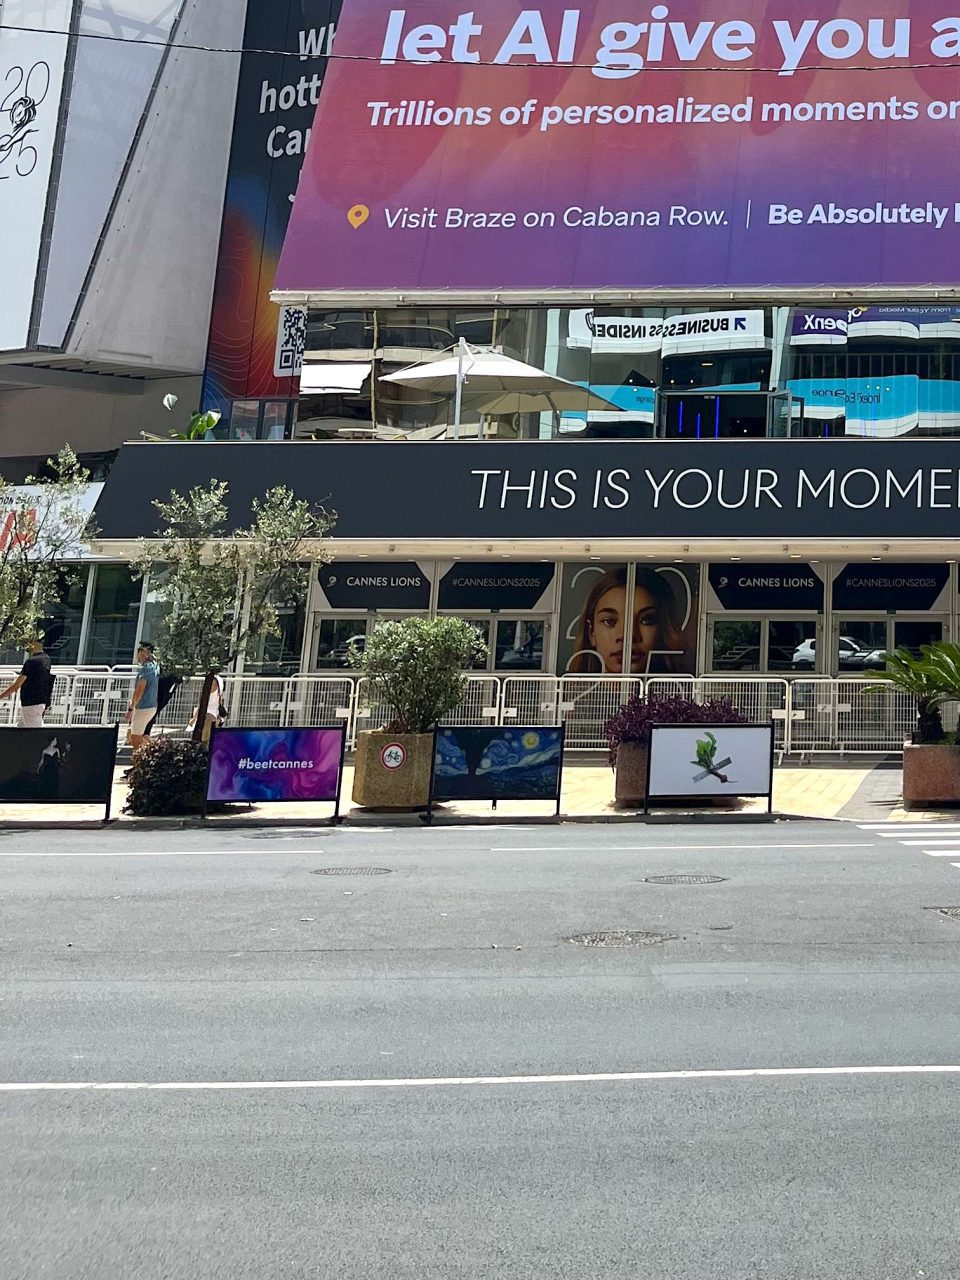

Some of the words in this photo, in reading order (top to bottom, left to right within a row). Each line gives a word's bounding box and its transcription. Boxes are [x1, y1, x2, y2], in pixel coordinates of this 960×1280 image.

[380, 10, 483, 65] let
[493, 10, 581, 64] AI
[591, 5, 756, 80] give
[771, 18, 911, 77] you
[366, 100, 492, 127] Trillions
[500, 99, 538, 125] of
[540, 96, 753, 132] personalized
[761, 96, 919, 122] moments
[384, 207, 438, 229] Visit
[444, 207, 517, 229] Braze
[524, 212, 555, 228] on
[562, 206, 661, 228] Cabana
[669, 205, 729, 227] Row.
[768, 203, 803, 225] Be
[808, 202, 949, 229] Absolutely
[471, 469, 577, 509] THIS
[592, 468, 630, 509] IS
[645, 468, 782, 509] YOUR
[346, 577, 388, 587] CANNES
[390, 577, 421, 587] LIONS
[452, 578, 540, 587] #CANNESLIONS2025
[738, 578, 780, 587] CANNES
[783, 578, 814, 587] LIONS
[846, 578, 936, 587] #CANNESLIONS2025
[238, 758, 313, 769] #beetcannes
